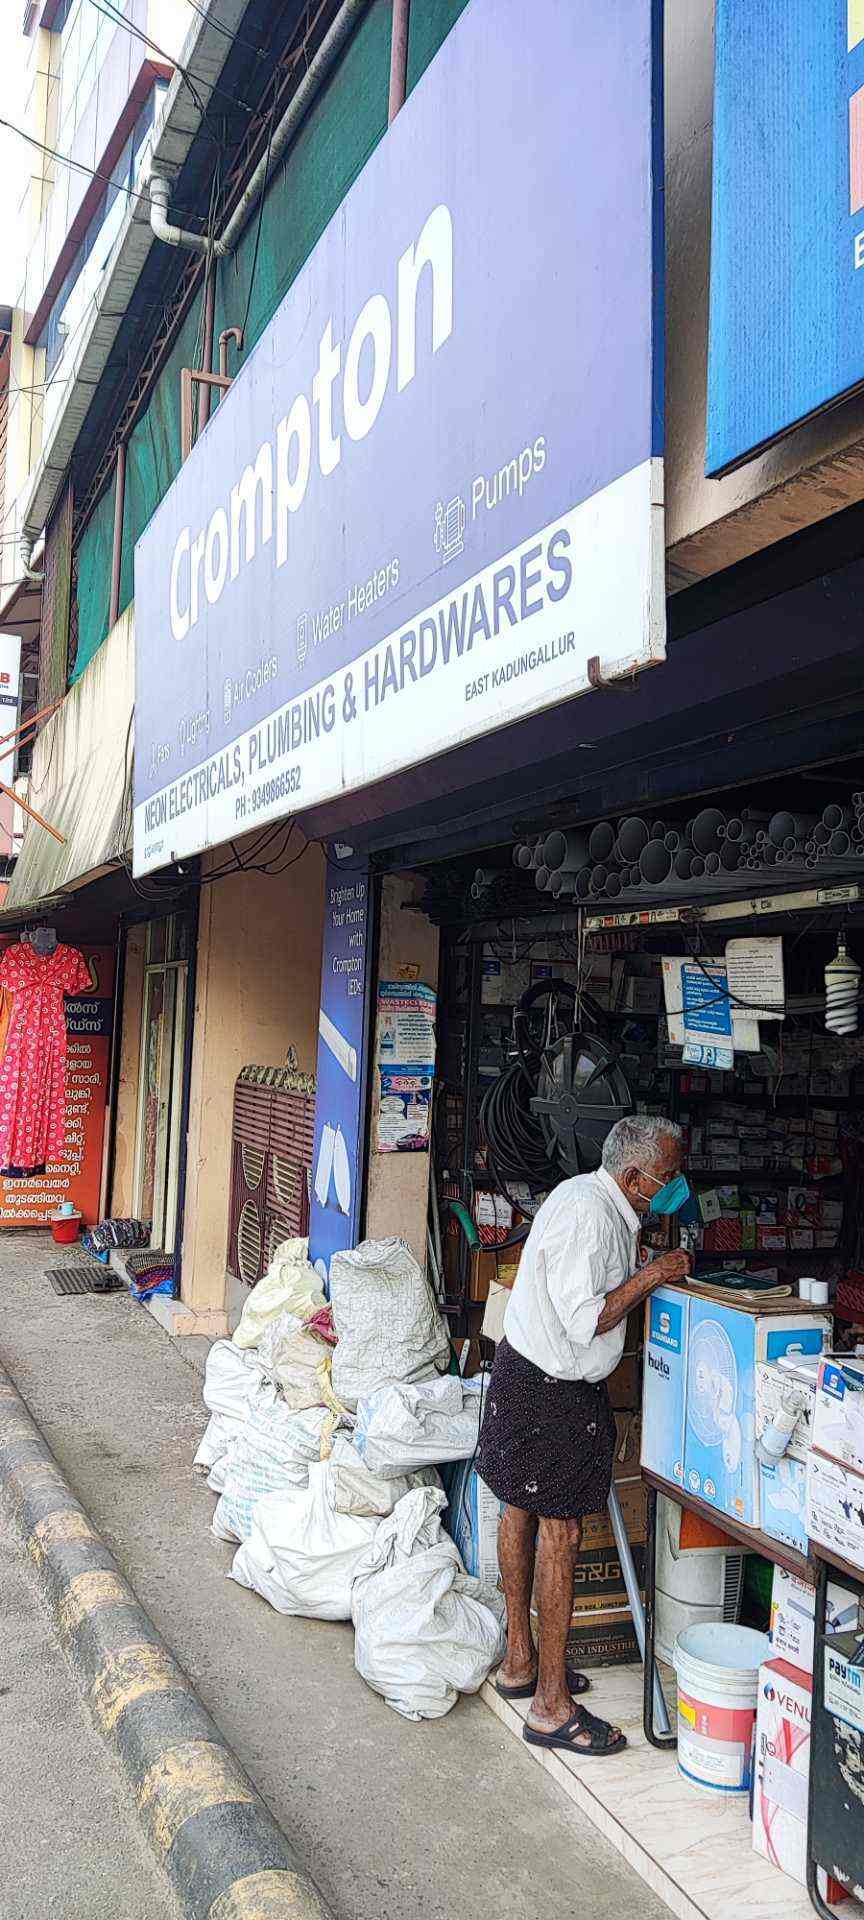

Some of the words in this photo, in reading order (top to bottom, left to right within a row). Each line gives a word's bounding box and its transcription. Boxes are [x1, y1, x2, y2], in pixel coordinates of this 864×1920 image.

[169, 204, 453, 640] Crompton
[471, 436, 547, 520] Pumps
[311, 602, 345, 647] Water
[348, 557, 400, 624] Heaters
[145, 792, 168, 834] NEON
[169, 745, 245, 820] ELECTRICALS,
[249, 684, 336, 776] PLUMBING
[342, 672, 358, 723] &
[364, 528, 573, 711] HARDWARES
[246, 656, 278, 698] Coolers
[465, 673, 489, 701] EAST
[492, 632, 576, 686] KADUNGALLUR
[330, 887, 355, 906] Brighten
[356, 882, 365, 901] Up
[332, 911, 345, 928] Your
[345, 908, 364, 924] Home
[348, 931, 364, 947] with
[332, 957, 362, 976] Crompton
[777, 1690, 811, 1723] VENU
